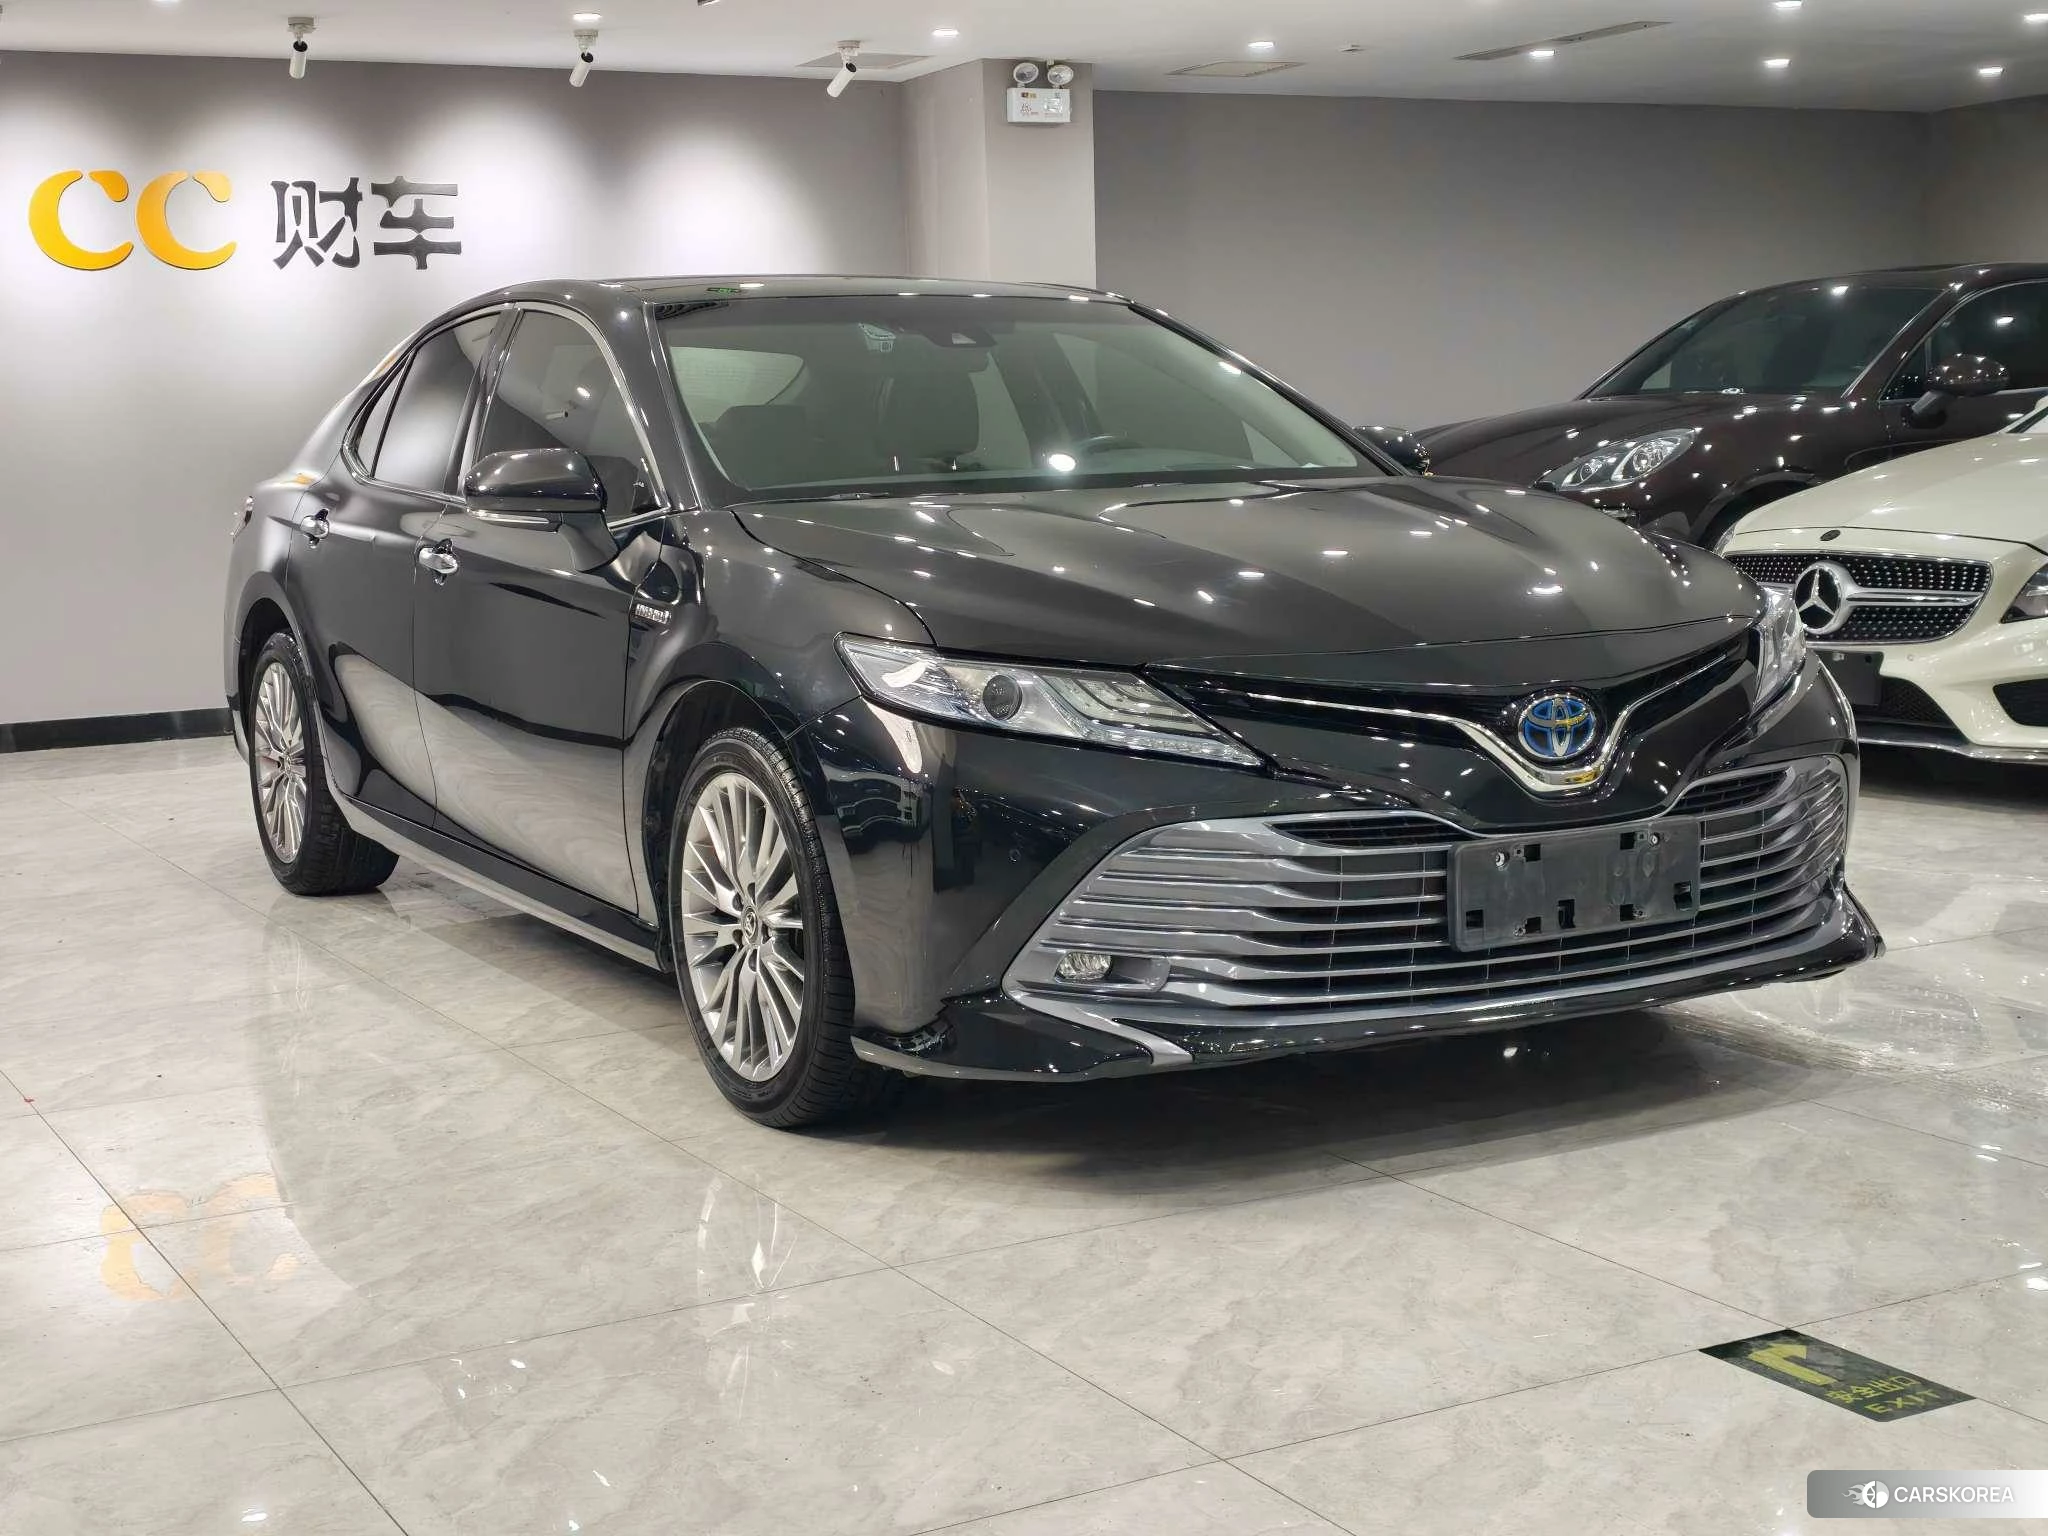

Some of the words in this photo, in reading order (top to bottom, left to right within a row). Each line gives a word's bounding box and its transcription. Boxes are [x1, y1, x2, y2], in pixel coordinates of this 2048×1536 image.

[28, 170, 237, 271] CC
[271, 175, 462, 270] 财车
[1824, 1375, 1922, 1404] 安全出口
[1863, 1389, 1941, 1414] EXIT
